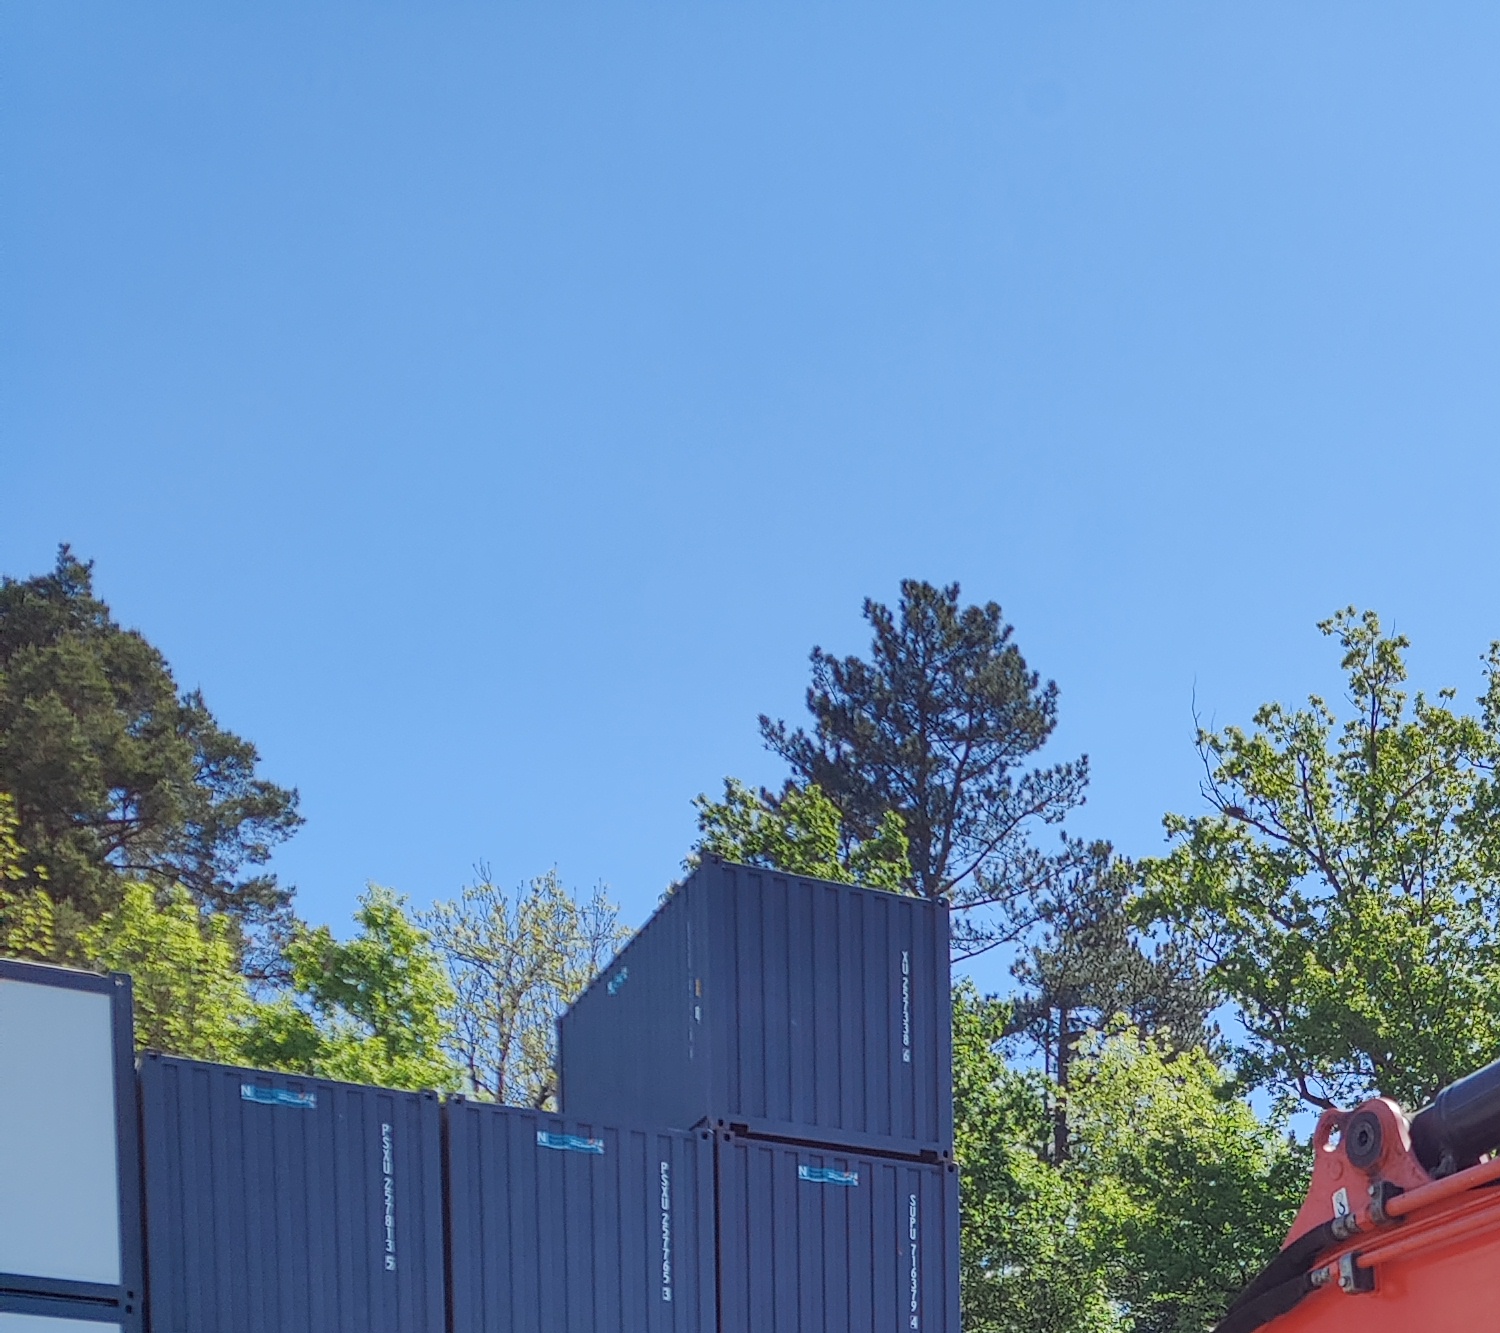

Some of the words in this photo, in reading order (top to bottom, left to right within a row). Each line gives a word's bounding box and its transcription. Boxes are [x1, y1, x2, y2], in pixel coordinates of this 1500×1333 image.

[382, 1123, 393, 1175] PSXU
[660, 1161, 670, 1210] PSXU
[384, 1177, 396, 1252] 257813
[909, 1194, 917, 1240] SUPU
[385, 1255, 397, 1271] 5
[661, 1212, 671, 1284] 257765
[910, 1243, 918, 1312] 716379
